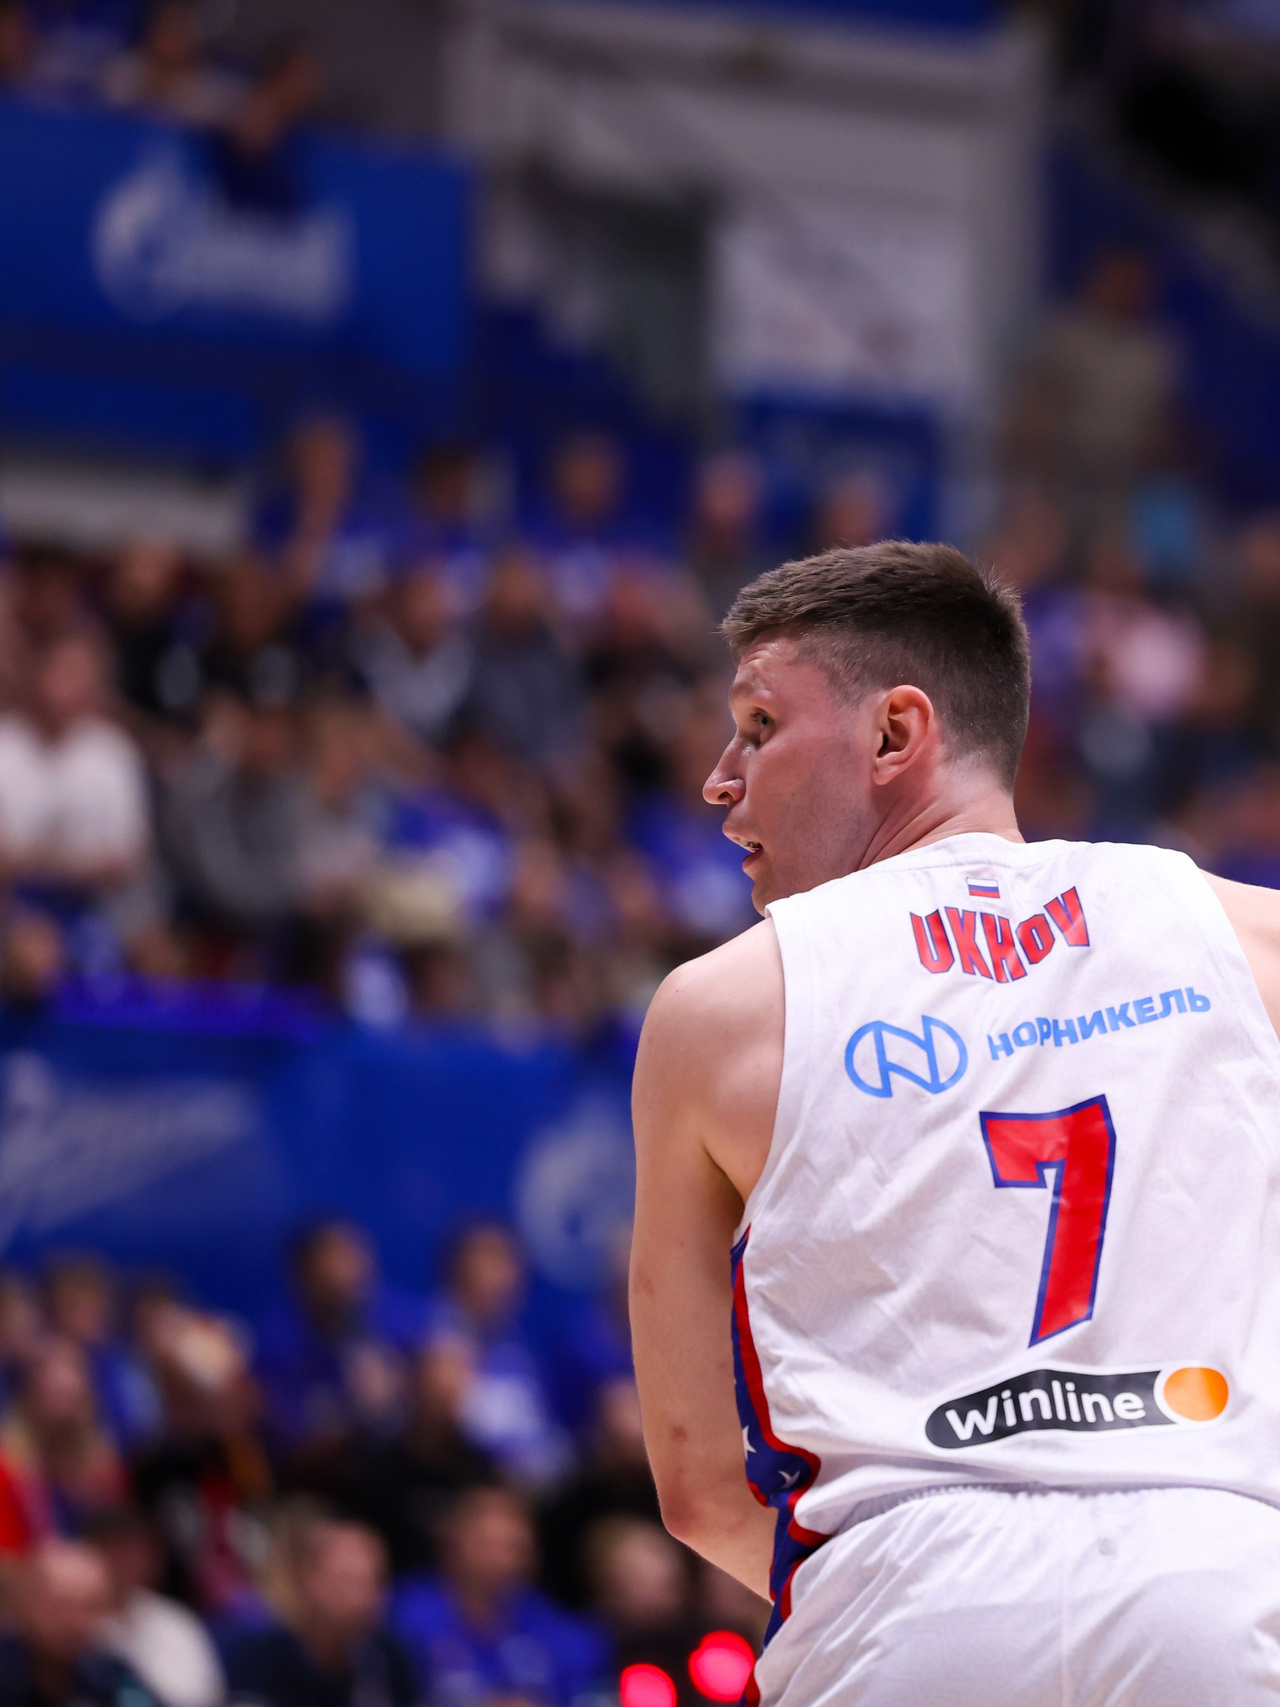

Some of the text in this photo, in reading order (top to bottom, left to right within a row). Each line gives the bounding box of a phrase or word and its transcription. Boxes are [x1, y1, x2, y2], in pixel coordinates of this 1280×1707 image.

[909, 885, 1091, 984] UKHOV
[987, 986, 1212, 1061] НОРНИКЕЛЬ
[979, 1093, 1117, 1349] 7
